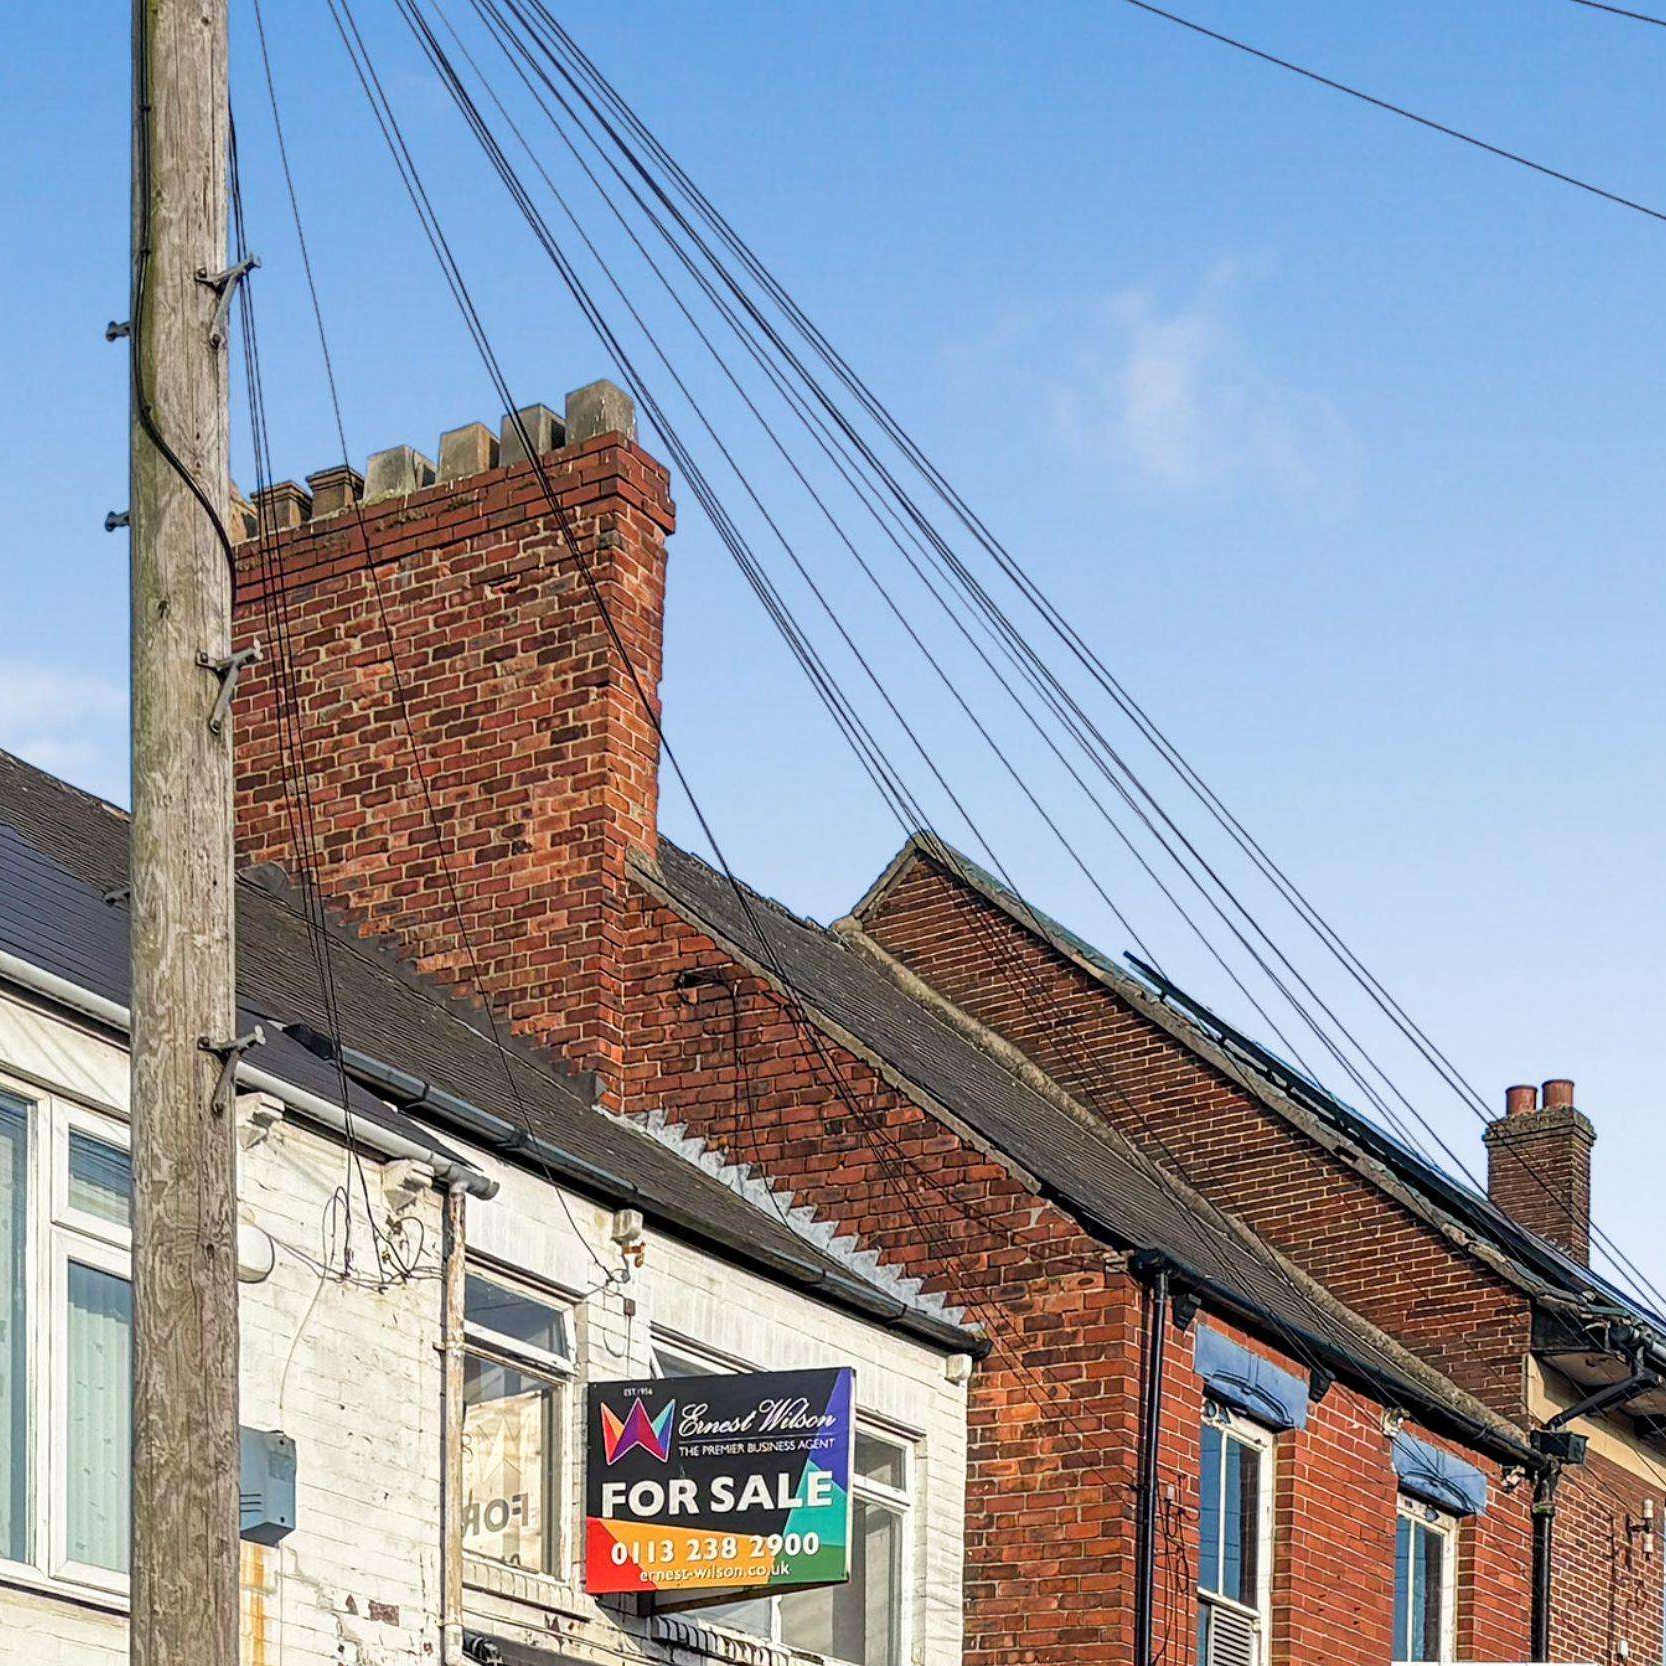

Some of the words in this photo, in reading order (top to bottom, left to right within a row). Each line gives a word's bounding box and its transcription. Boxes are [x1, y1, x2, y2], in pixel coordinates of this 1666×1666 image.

[679, 1403, 756, 1437] Ernest
[758, 1397, 836, 1433] Wilson
[679, 1445, 700, 1457] THE
[702, 1443, 745, 1456] PREMIER
[747, 1441, 796, 1453] BUSINESS
[798, 1438, 835, 1450] AGENT
[602, 1478, 700, 1518] FOR
[710, 1471, 833, 1512] SALE
[611, 1539, 674, 1565] 0113
[687, 1536, 737, 1561] 238
[749, 1532, 819, 1557] 2900
[640, 1561, 790, 1583] ernest-wilson.co.uk
